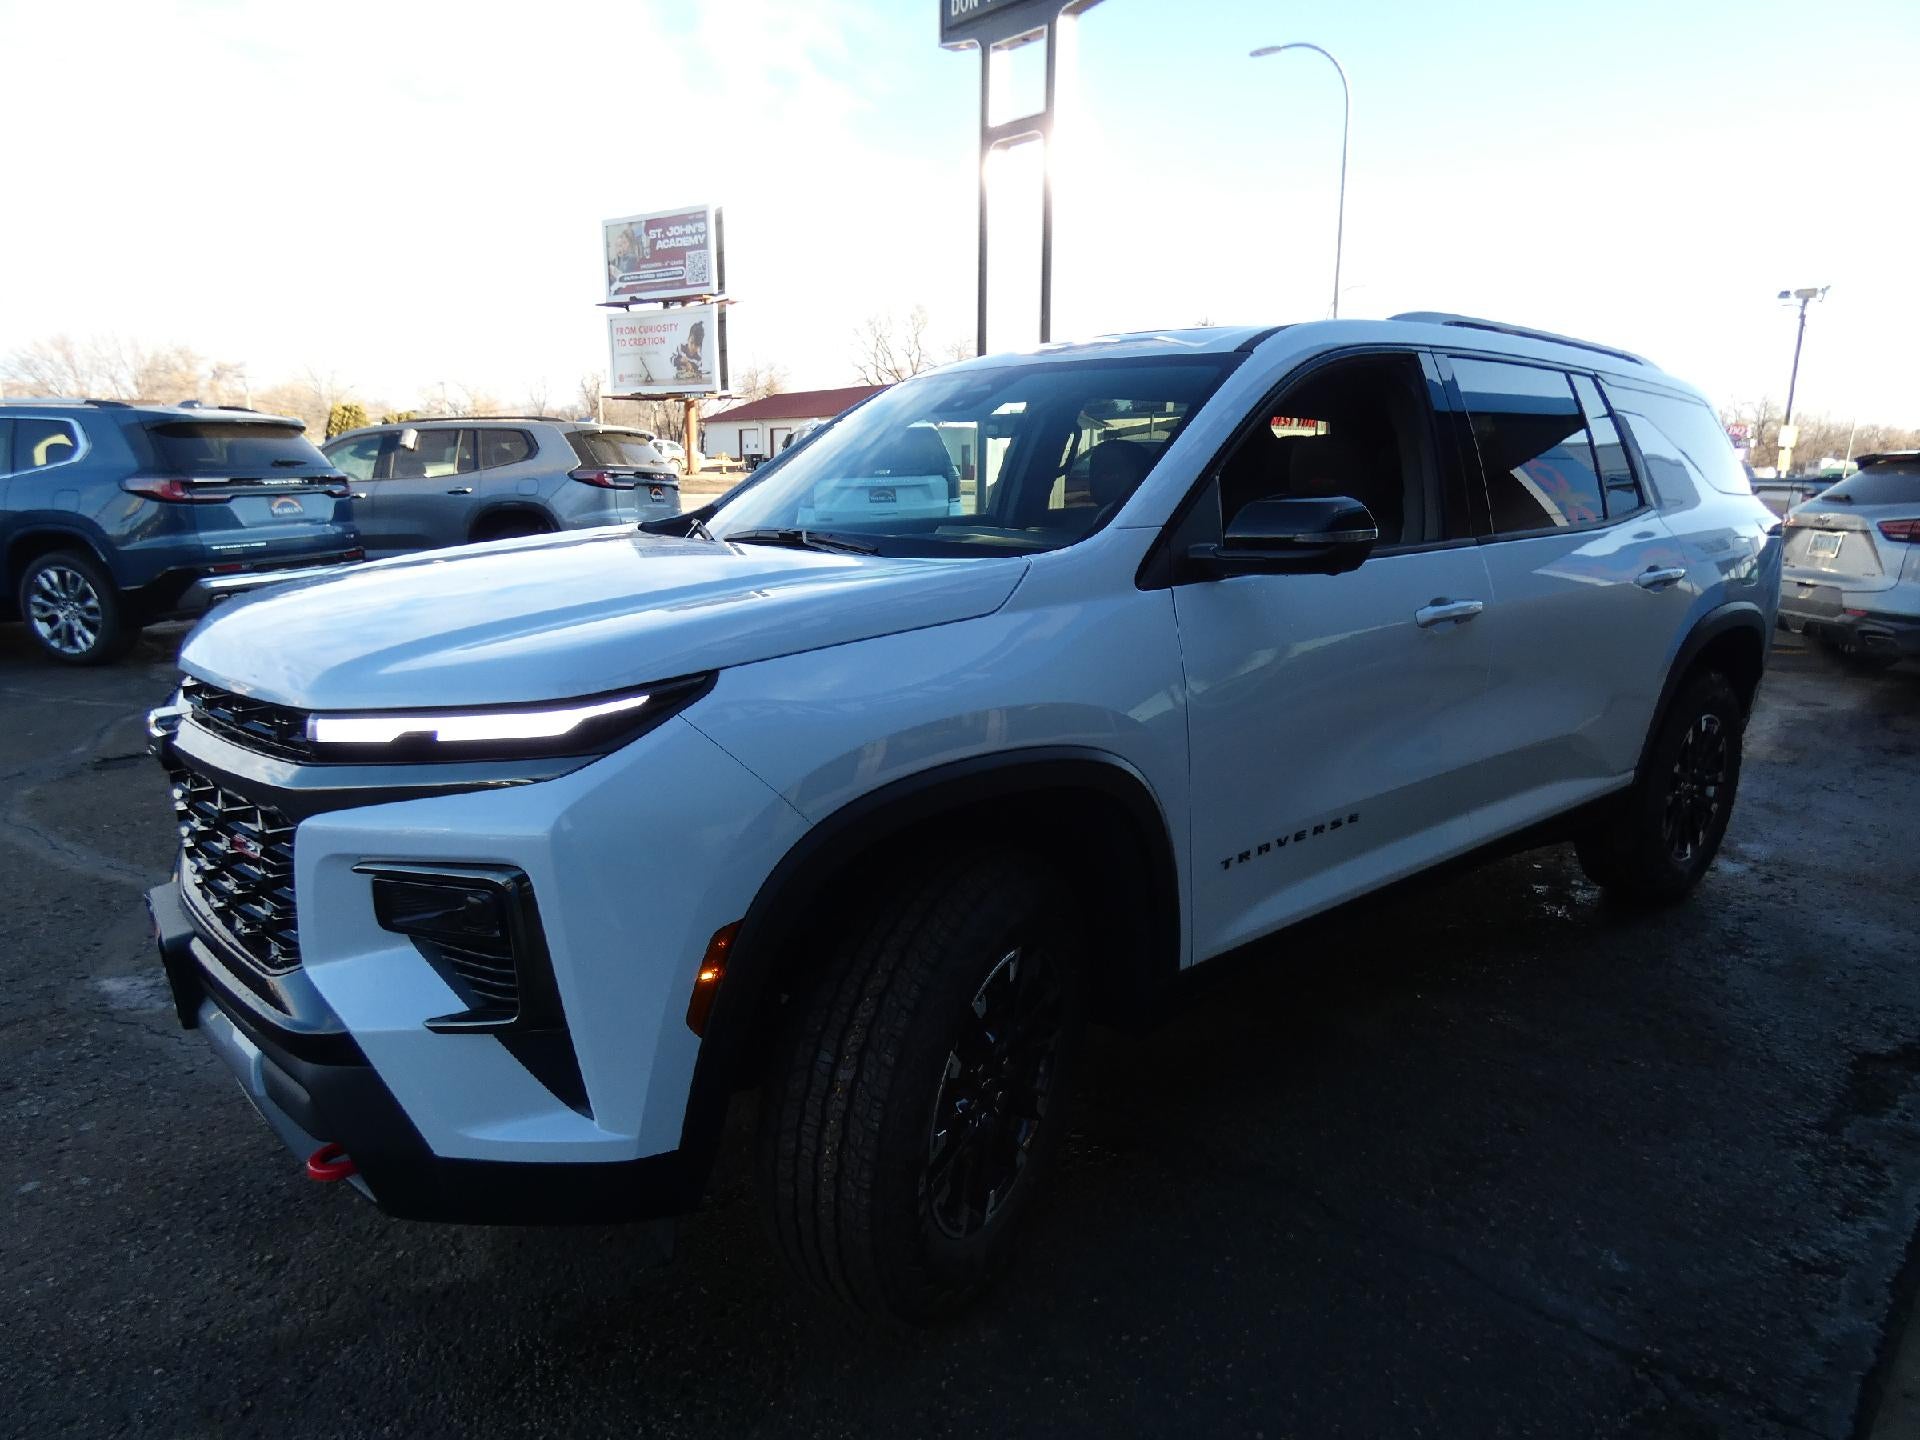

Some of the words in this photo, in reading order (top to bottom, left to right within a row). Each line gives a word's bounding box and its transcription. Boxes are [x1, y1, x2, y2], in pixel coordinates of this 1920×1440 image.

[648, 228, 665, 239] ST.
[666, 221, 706, 237] JOHN'S
[655, 234, 706, 250] ACADEMY
[616, 326, 636, 335] FROM
[638, 322, 679, 334] CURIOSITY
[616, 338, 627, 347] TO
[628, 336, 666, 347] CREATION
[1221, 813, 1360, 871] TRAVERSE
